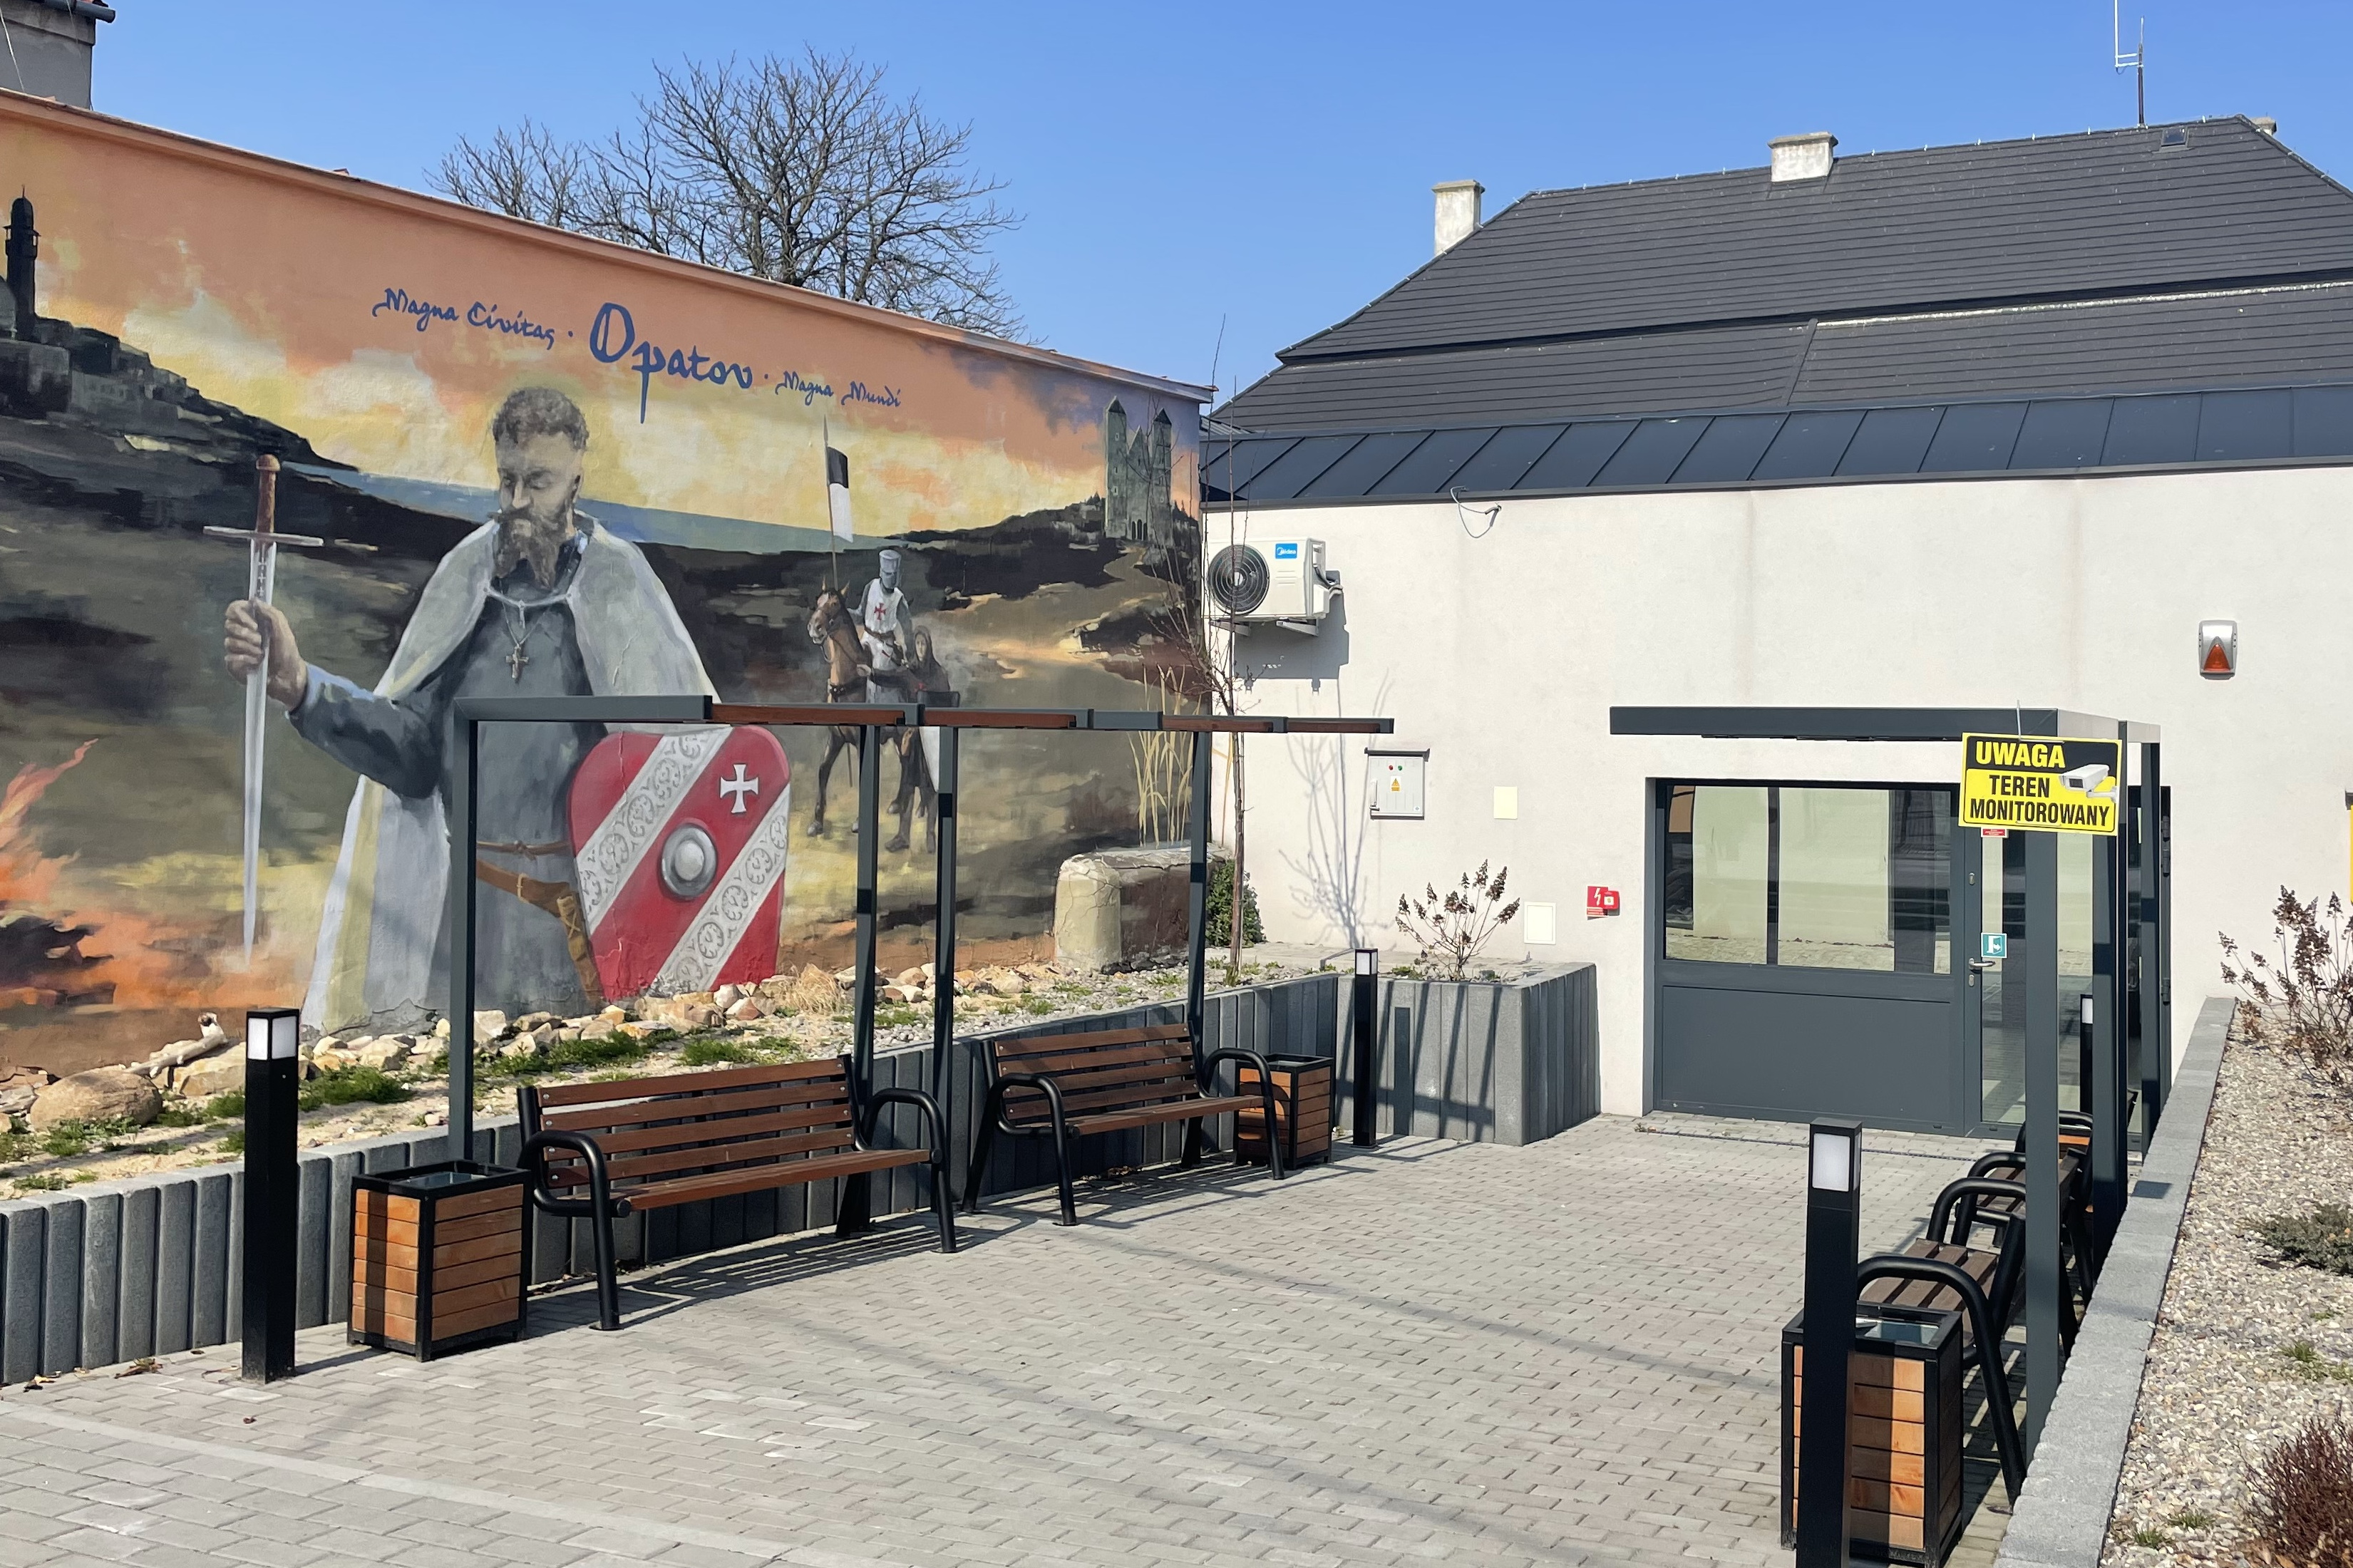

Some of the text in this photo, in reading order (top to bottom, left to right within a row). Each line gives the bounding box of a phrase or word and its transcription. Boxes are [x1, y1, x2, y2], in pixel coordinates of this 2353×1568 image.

[372, 288, 459, 331] Magna
[468, 301, 555, 350] Civitas
[775, 371, 834, 406] Magna
[840, 381, 902, 407] Mundi
[1976, 741, 2066, 768] UWAGA
[1989, 774, 2050, 798] TEREN
[1970, 798, 2110, 827] MONITOROWANY
